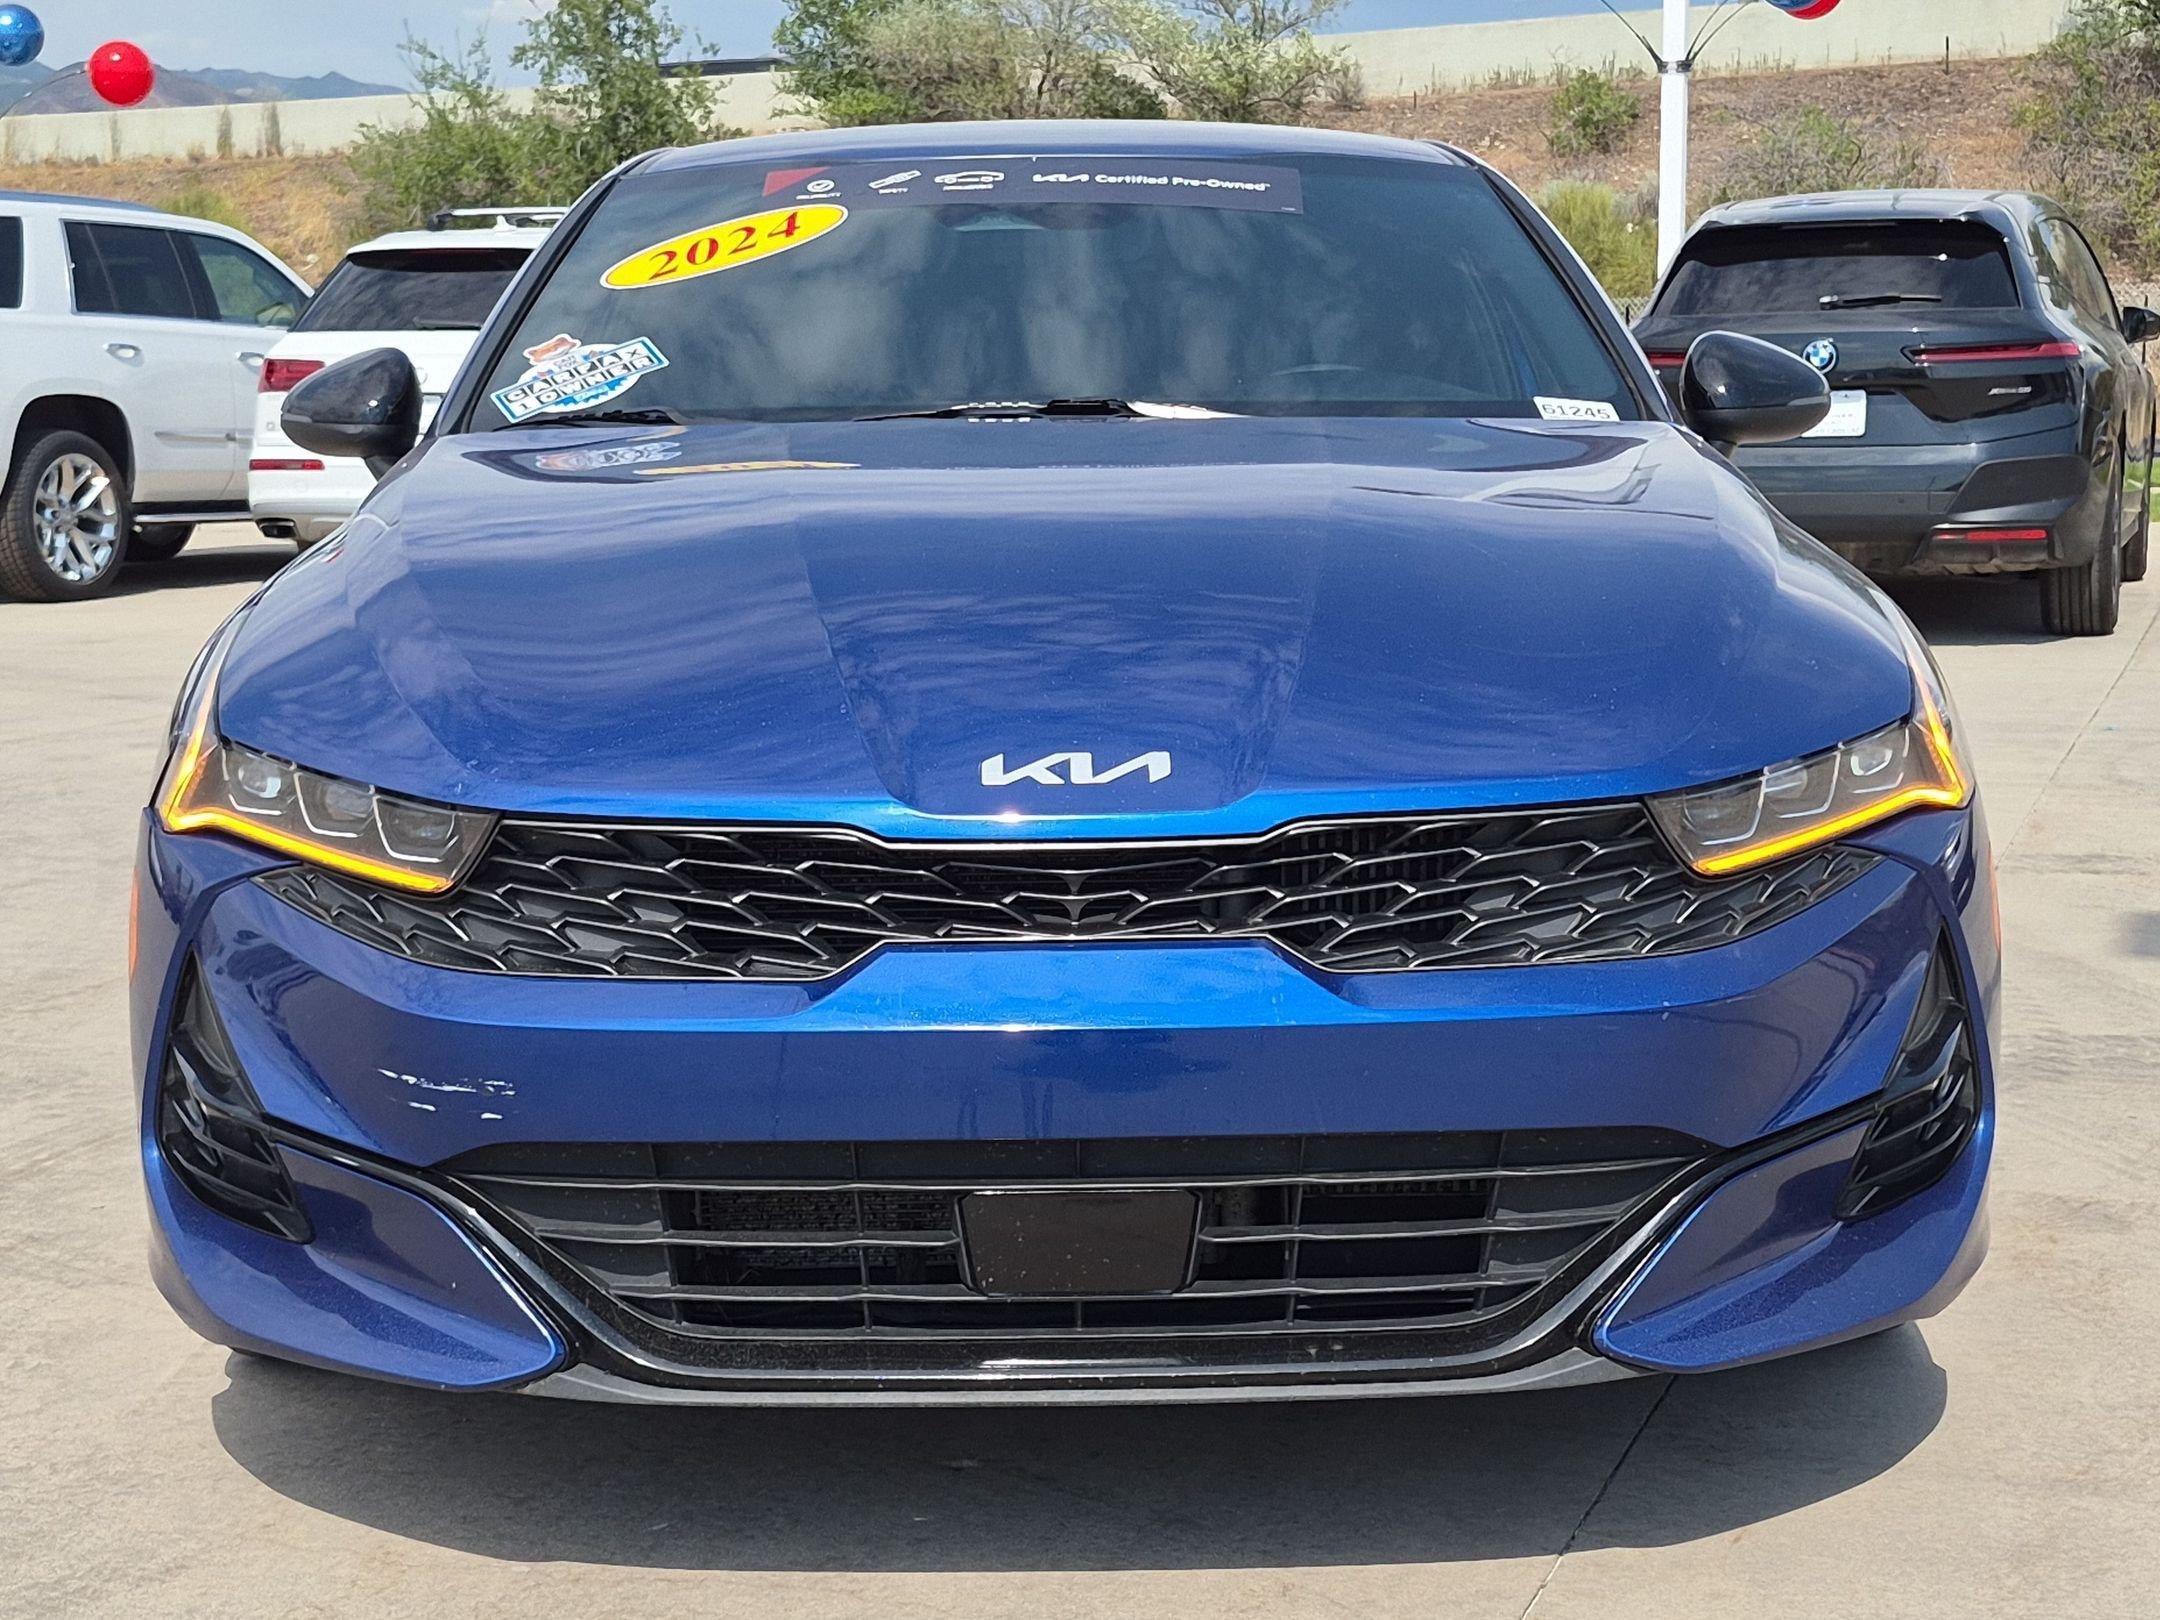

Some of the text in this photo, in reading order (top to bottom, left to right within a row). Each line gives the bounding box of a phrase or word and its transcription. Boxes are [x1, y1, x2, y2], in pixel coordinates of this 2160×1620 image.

[1095, 174, 1169, 186] Certified
[649, 211, 800, 281] 2024
[504, 348, 644, 403] CARFAX
[537, 355, 655, 404] OWNER
[1542, 404, 1611, 419] 61245
[981, 751, 1172, 786] KIA
